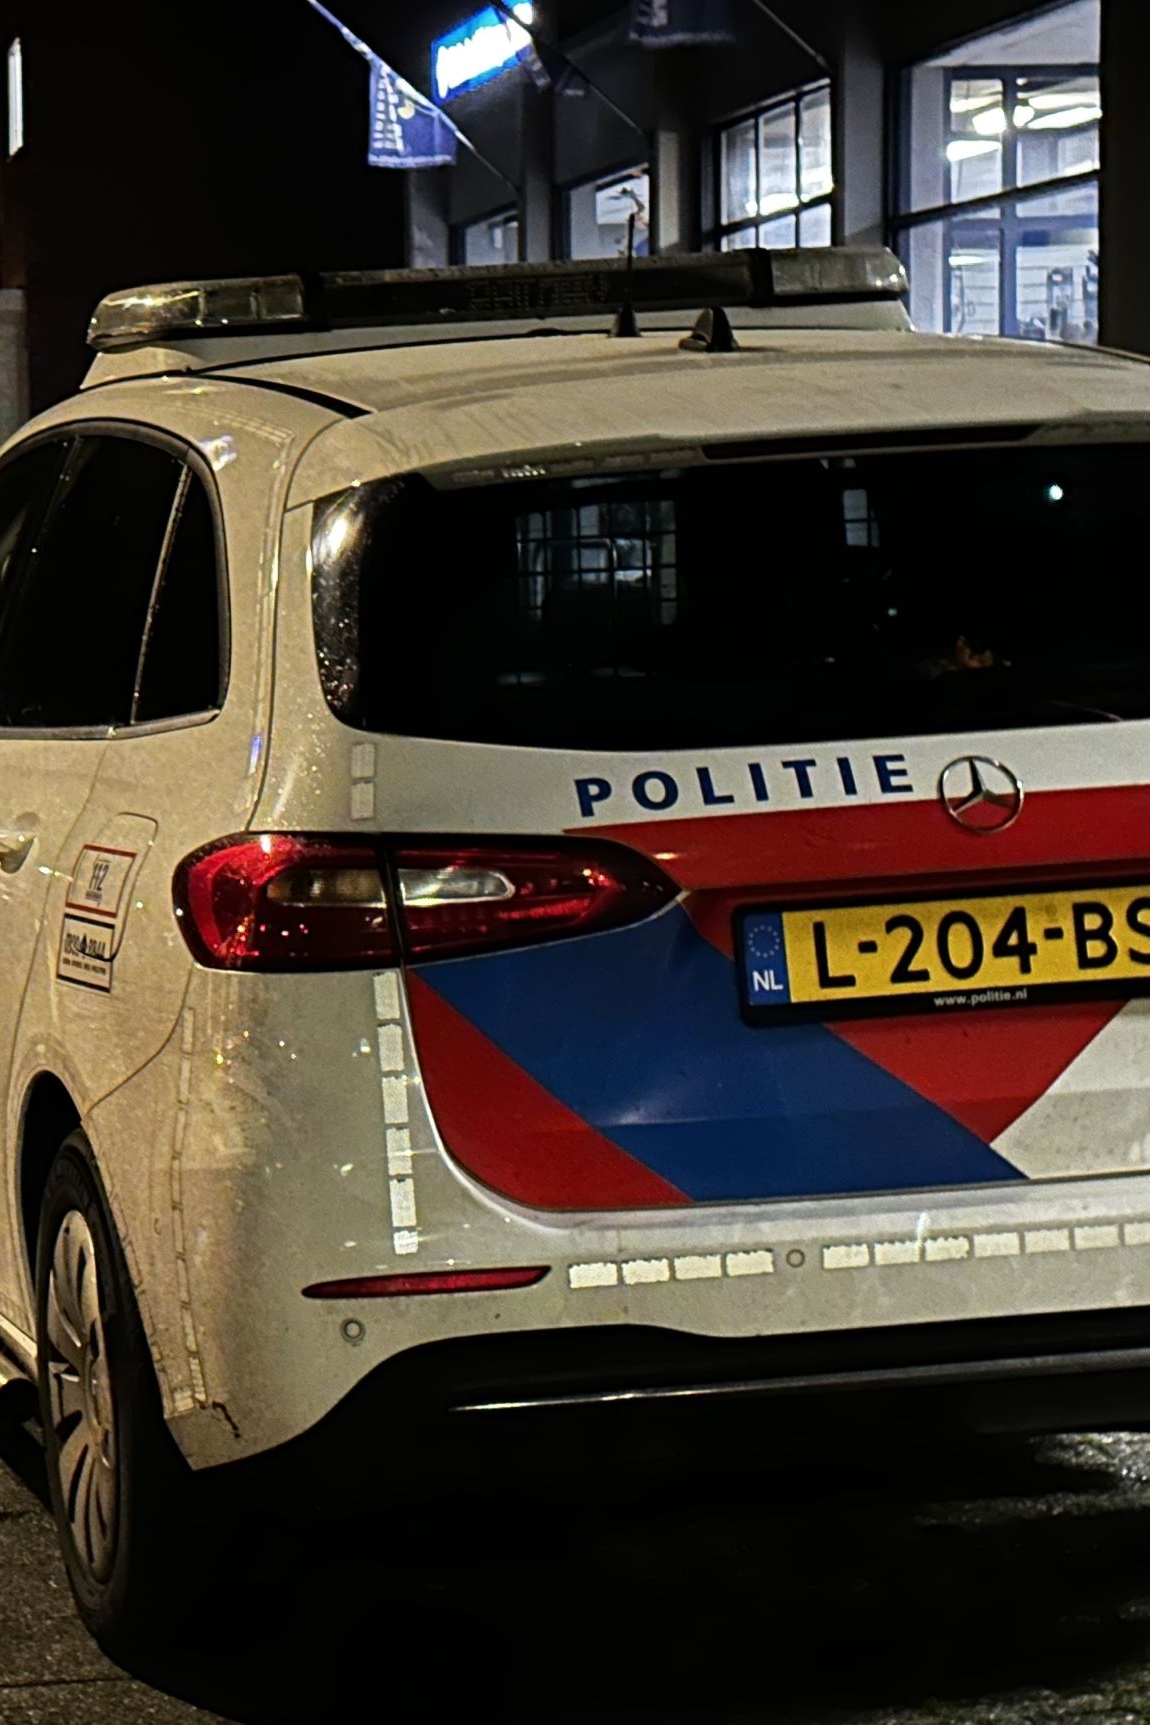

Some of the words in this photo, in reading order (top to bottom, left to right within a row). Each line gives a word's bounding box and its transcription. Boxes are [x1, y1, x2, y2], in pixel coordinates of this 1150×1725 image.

[574, 754, 914, 817] POLITIE
[752, 970, 784, 993] NL
[933, 987, 1028, 1007] www.politie.nl
